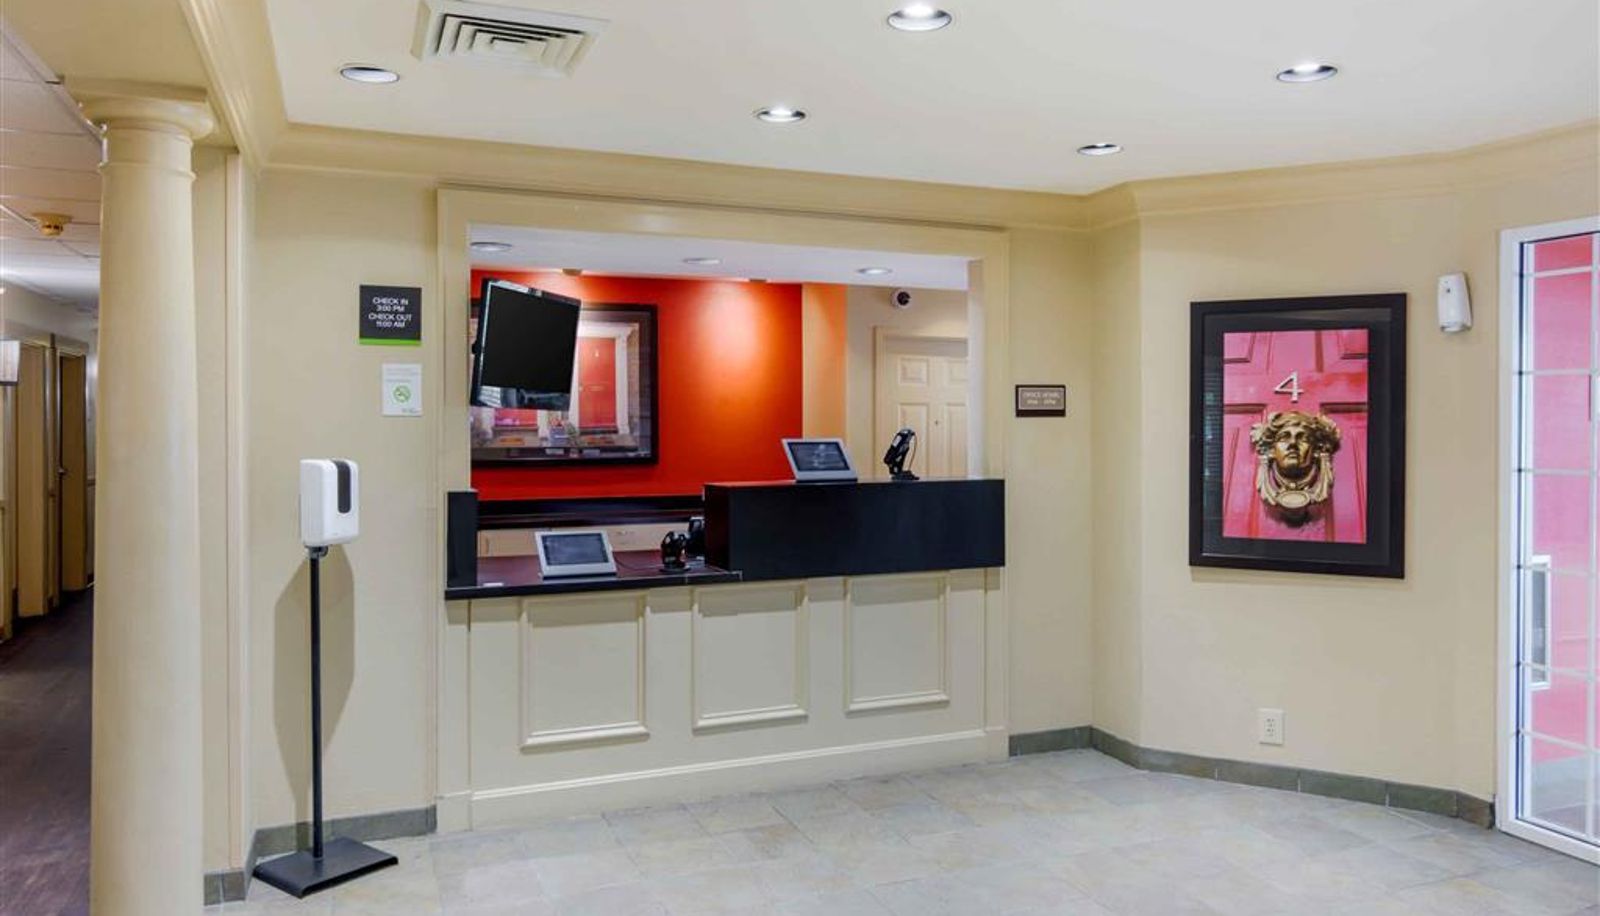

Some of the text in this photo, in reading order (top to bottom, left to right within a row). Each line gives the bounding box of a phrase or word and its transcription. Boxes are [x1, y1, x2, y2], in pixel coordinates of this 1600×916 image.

[372, 297, 399, 305] CHECK
[368, 312, 411, 321] CHECK OUT
[1274, 371, 1304, 401] 4
